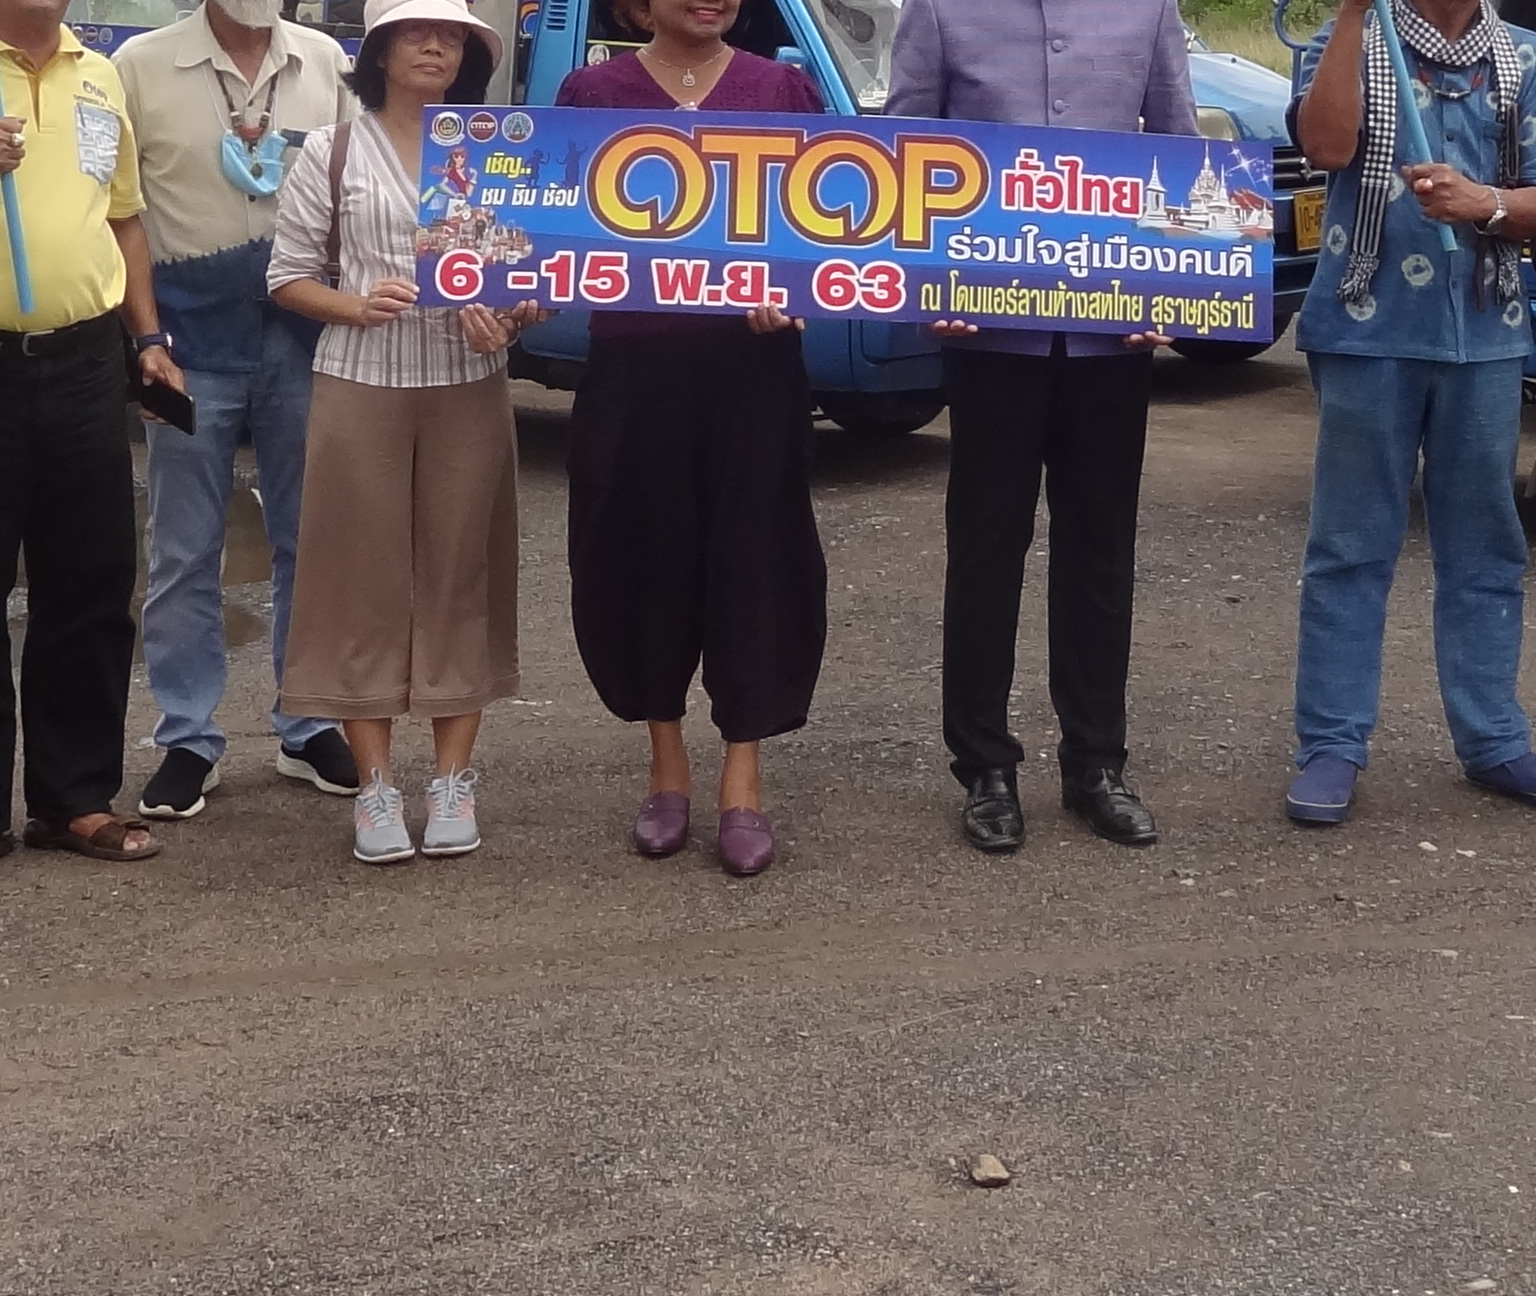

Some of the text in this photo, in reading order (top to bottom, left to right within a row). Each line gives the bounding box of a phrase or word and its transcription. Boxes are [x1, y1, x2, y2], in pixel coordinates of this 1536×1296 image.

[481, 183, 580, 207] ชม ชิม ช้อป
[586, 123, 990, 252] OTOP
[1001, 148, 1144, 217] ทั่วไทย
[947, 225, 1254, 278] ร่วมใจสู่เมืองคนดี
[651, 258, 788, 308] พ.ย.
[811, 259, 906, 313] 63
[920, 271, 1254, 335] ณ โดมแอร์ลานห้างสหไทย สุราษฎร์ธานี
